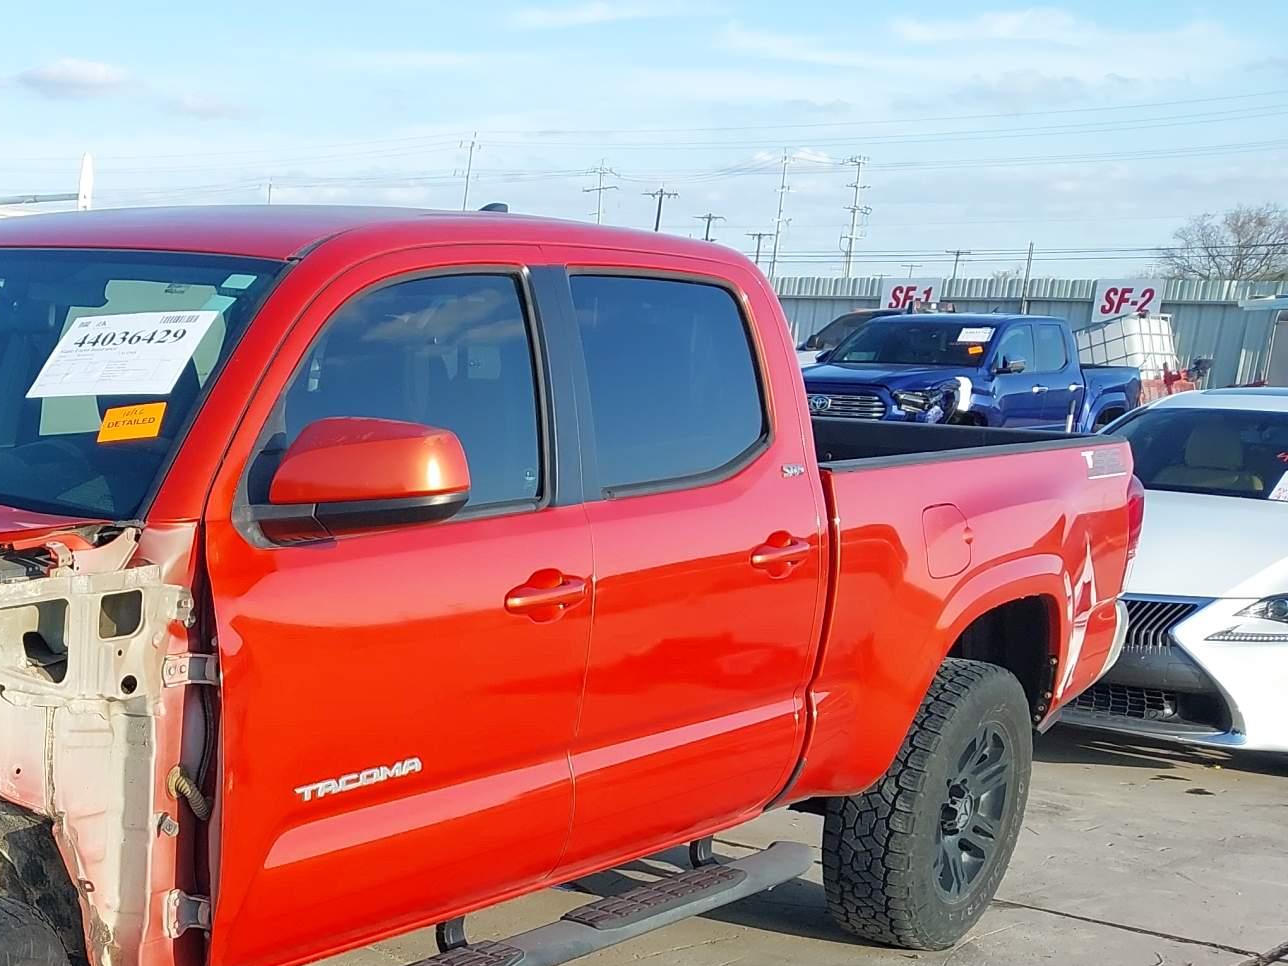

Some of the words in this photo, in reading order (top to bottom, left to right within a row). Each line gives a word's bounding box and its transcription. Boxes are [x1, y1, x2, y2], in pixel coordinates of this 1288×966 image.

[888, 286, 933, 309] SF-1
[1100, 287, 1155, 315] SF-2
[73, 328, 187, 348] 44036429
[107, 416, 156, 429] DETAILED
[294, 757, 422, 801] TACOMA
